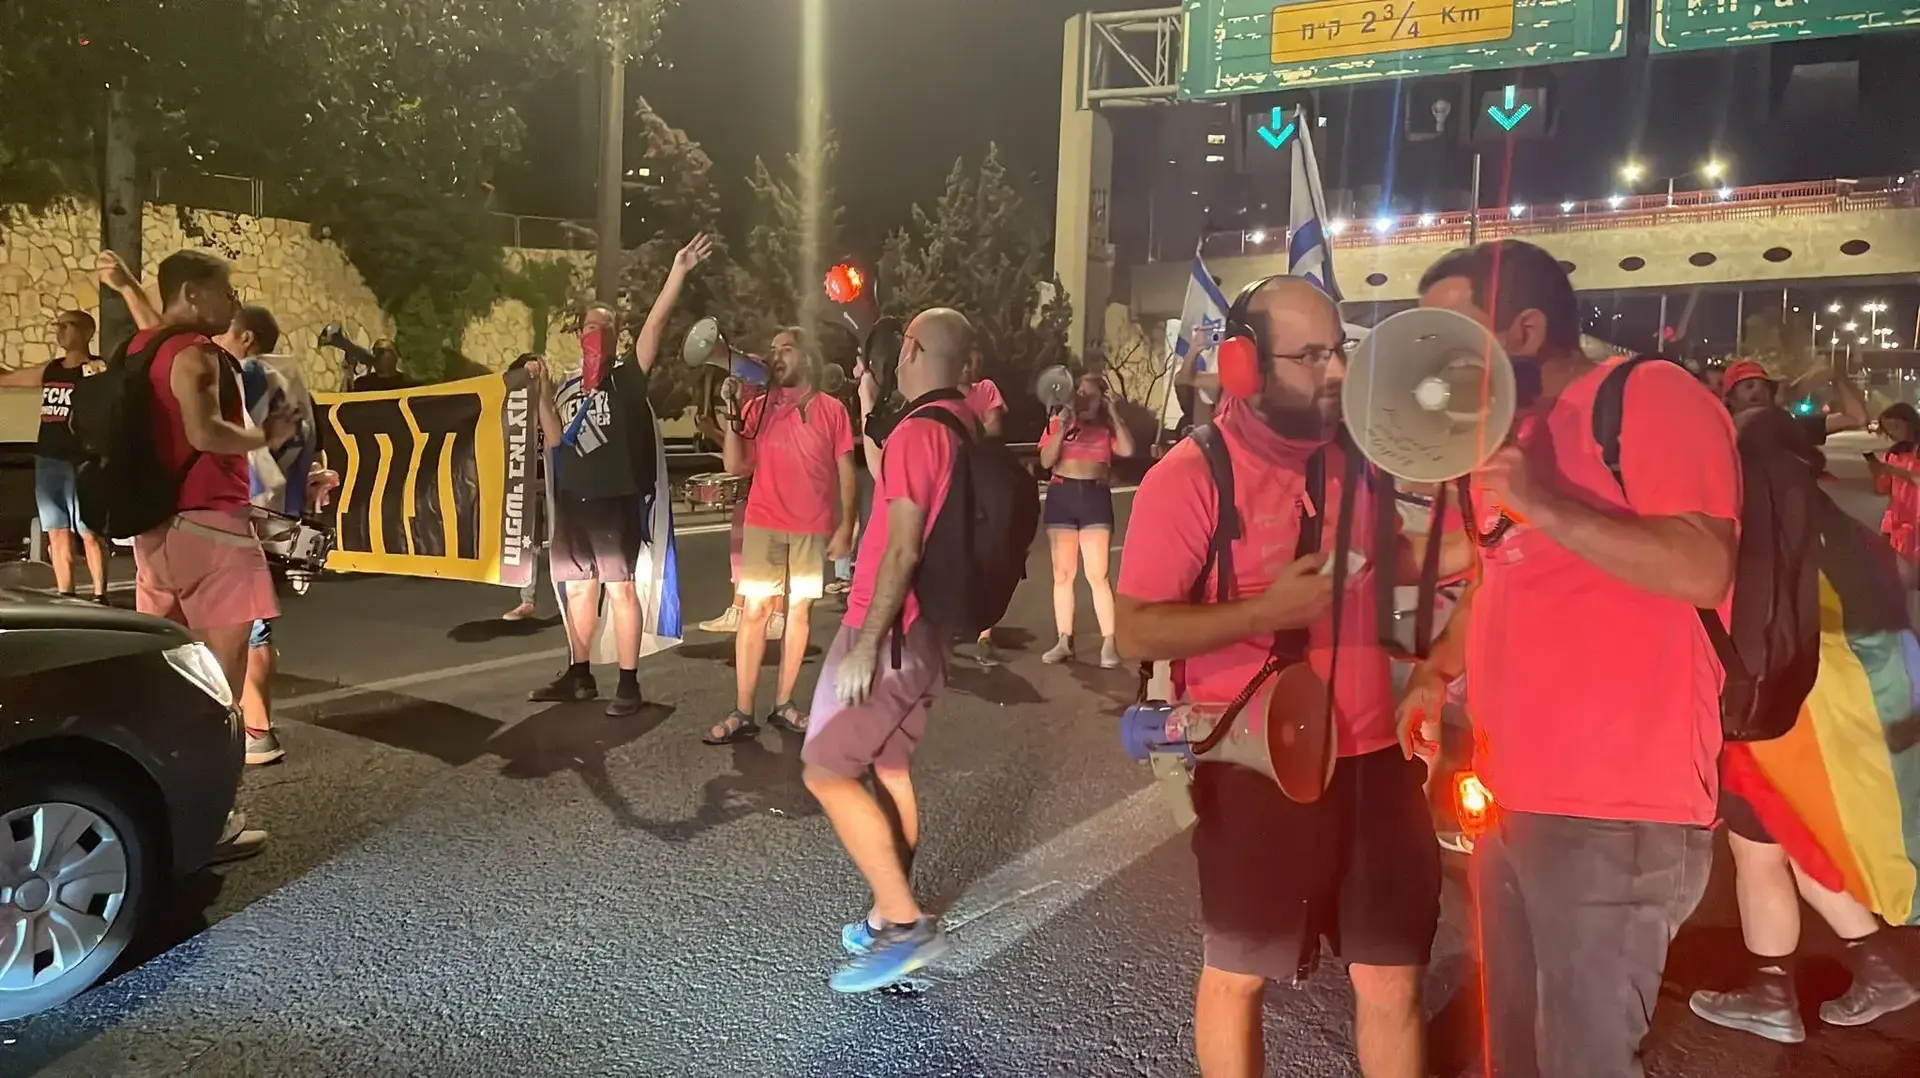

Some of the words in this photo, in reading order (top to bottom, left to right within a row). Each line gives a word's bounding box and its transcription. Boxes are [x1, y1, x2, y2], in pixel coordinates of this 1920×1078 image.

[1442, 6, 1480, 25] Km
[42, 387, 74, 406] FCK
[507, 387, 528, 479] בארצנו
[503, 483, 524, 566] חופשי
